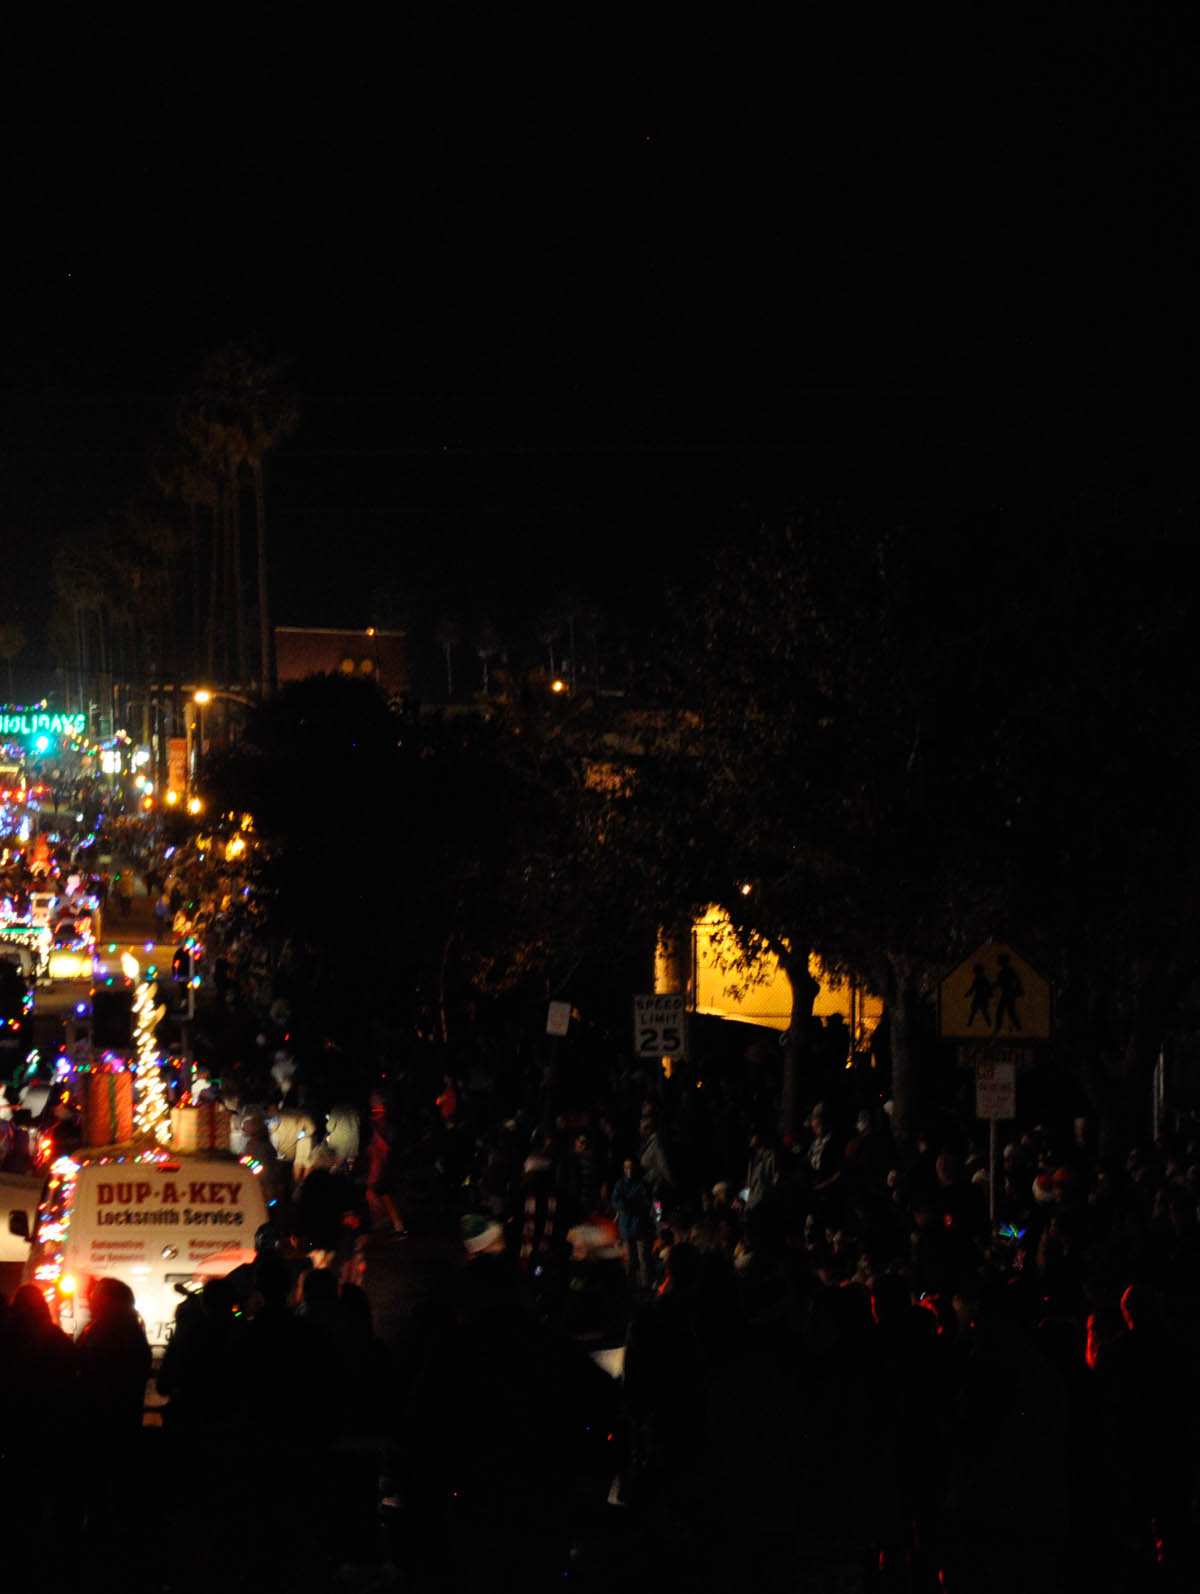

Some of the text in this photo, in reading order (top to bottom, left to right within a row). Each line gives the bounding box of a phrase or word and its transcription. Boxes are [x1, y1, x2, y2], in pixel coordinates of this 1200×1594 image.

[637, 996, 682, 1009] SPEED
[640, 1014, 678, 1025] LIMIT
[640, 1028, 680, 1051] 25
[97, 1209, 243, 1226] Locksmith Service
